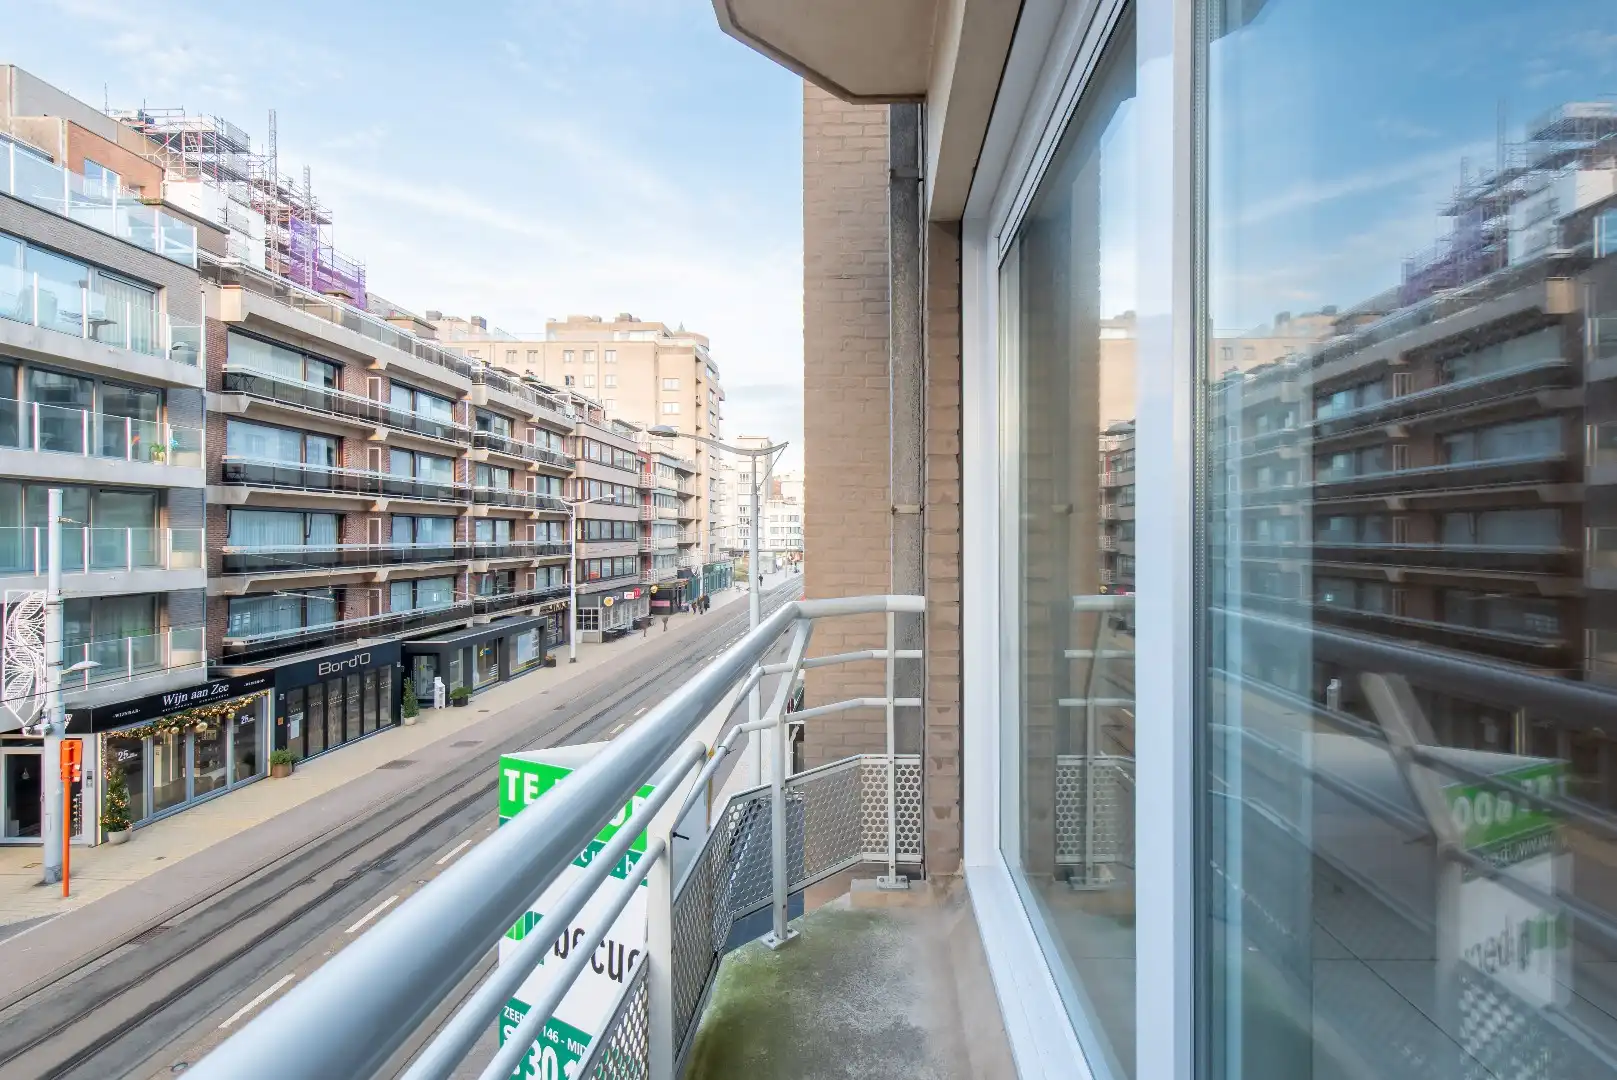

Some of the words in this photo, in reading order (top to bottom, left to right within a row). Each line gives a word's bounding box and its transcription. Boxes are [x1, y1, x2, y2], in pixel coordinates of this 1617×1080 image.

[318, 652, 371, 676] Bord'O
[162, 692, 188, 706] Wijn
[190, 688, 209, 700] aan
[210, 683, 230, 695] Zee
[503, 768, 539, 805] TE
